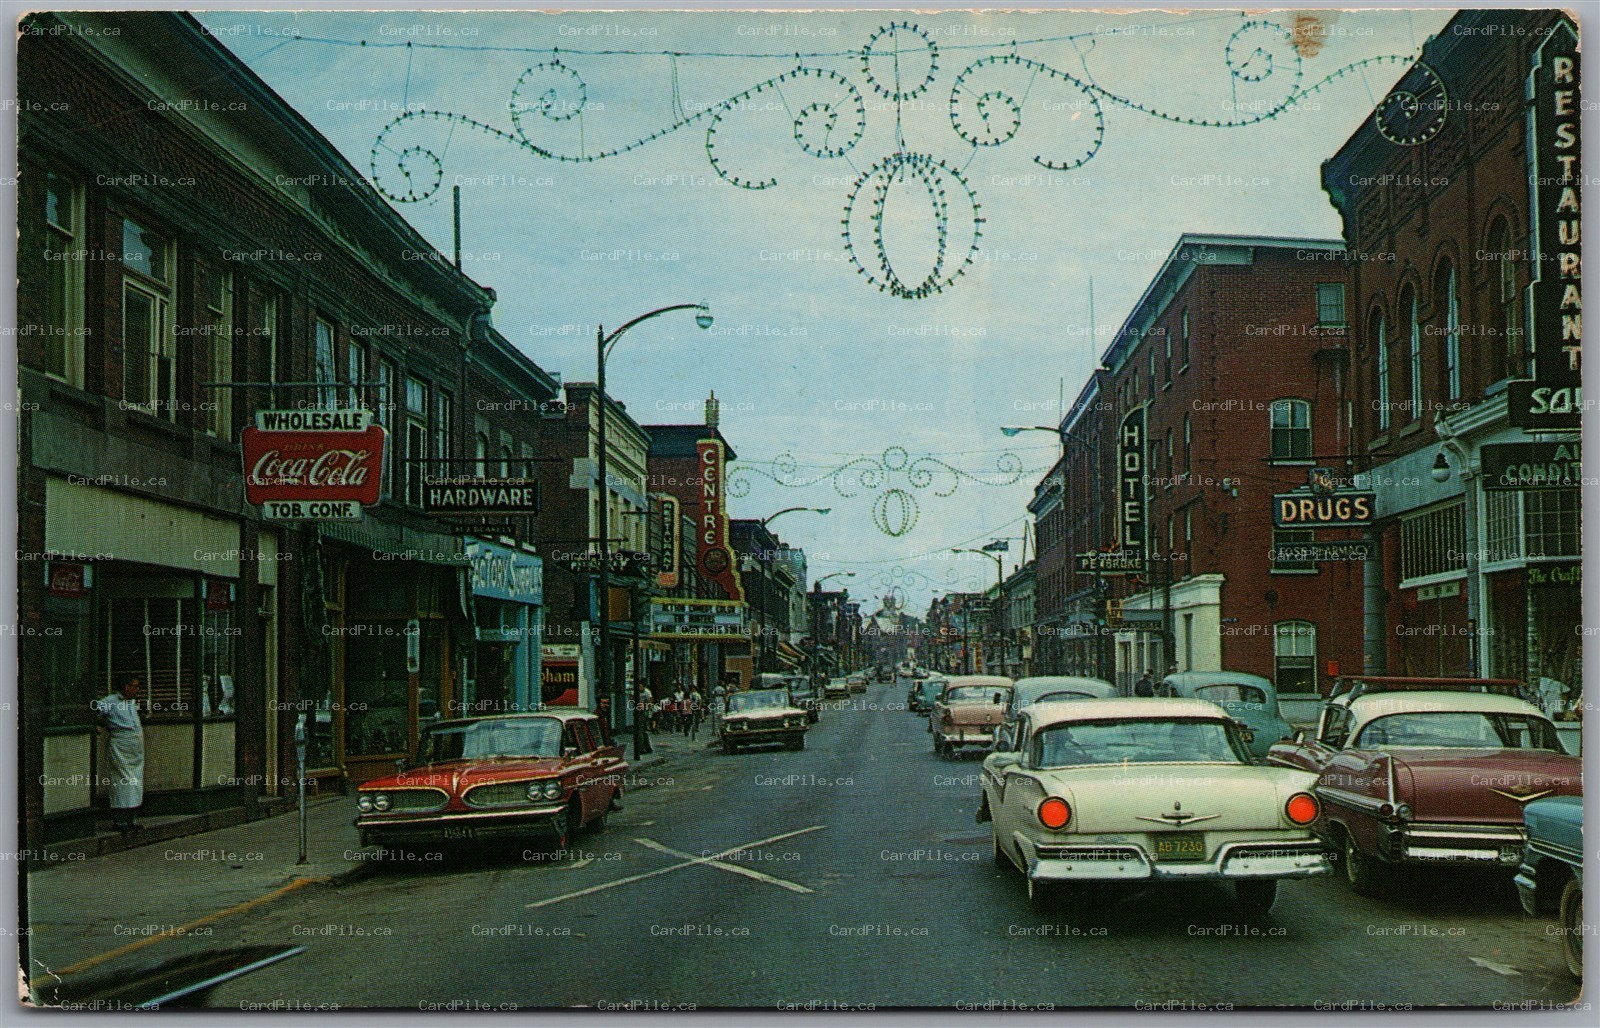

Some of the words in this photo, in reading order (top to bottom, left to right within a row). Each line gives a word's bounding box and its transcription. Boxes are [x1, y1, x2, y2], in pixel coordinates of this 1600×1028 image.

[1553, 56, 1582, 371] RESTAURANT
[263, 412, 362, 431] WHOLESALE
[430, 488, 534, 506] HARDWARE
[702, 450, 717, 545] CENTRE
[1123, 425, 1140, 546] HOTEL
[270, 503, 305, 517] TOB.
[309, 503, 353, 517] CONF.
[1281, 497, 1370, 522] DRUGS
